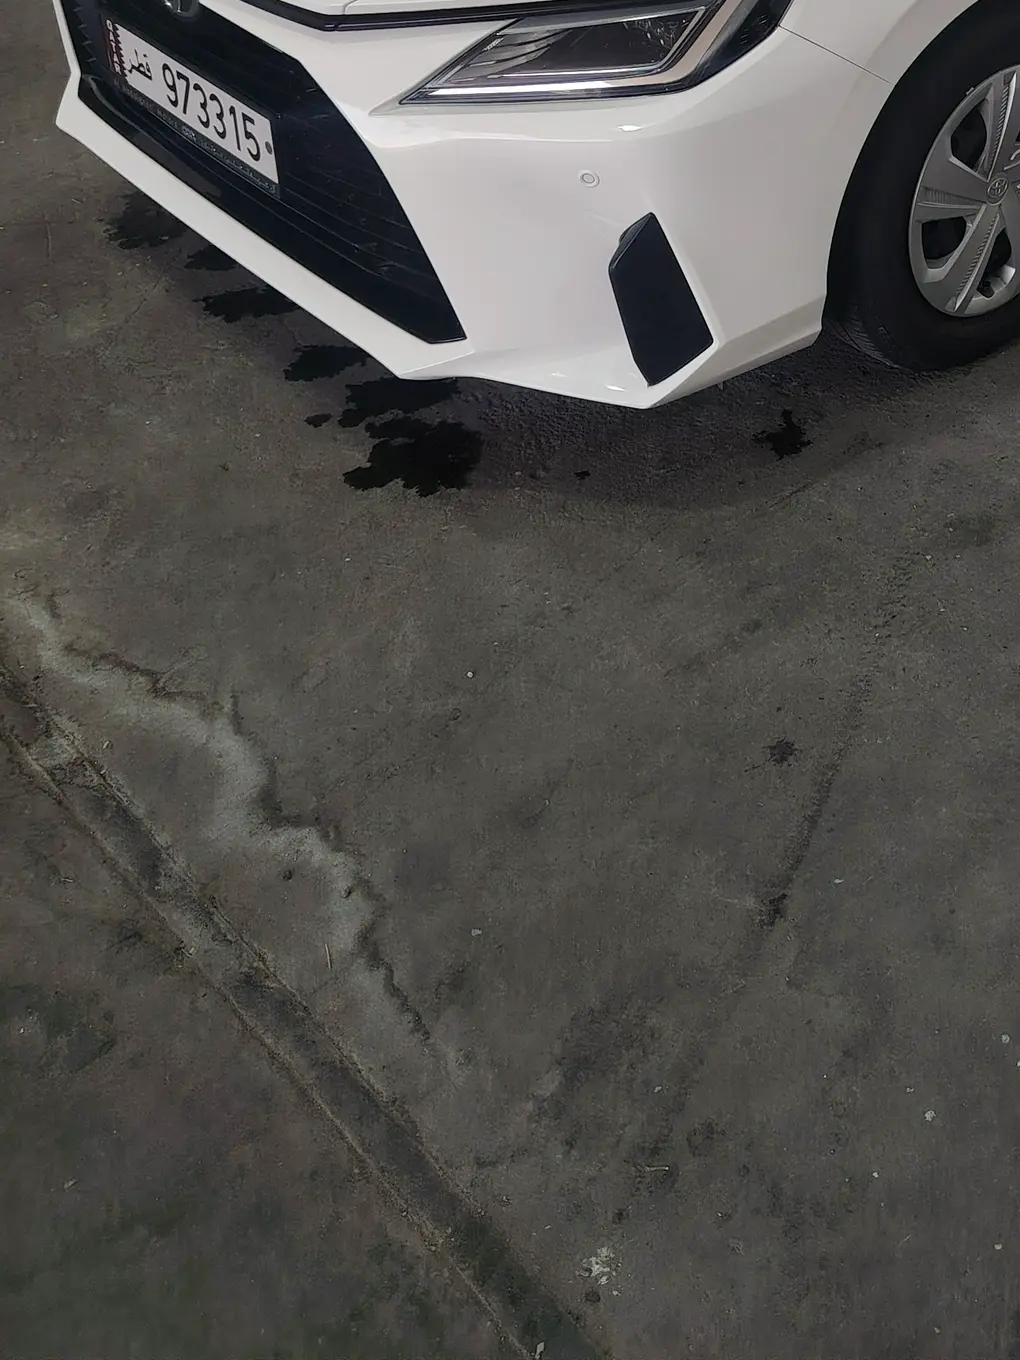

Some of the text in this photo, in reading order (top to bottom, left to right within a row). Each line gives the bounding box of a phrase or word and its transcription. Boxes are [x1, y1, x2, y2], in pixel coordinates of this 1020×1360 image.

[106, 19, 122, 75] QATAR
[126, 49, 152, 80] قطر
[162, 62, 261, 162] 973315
